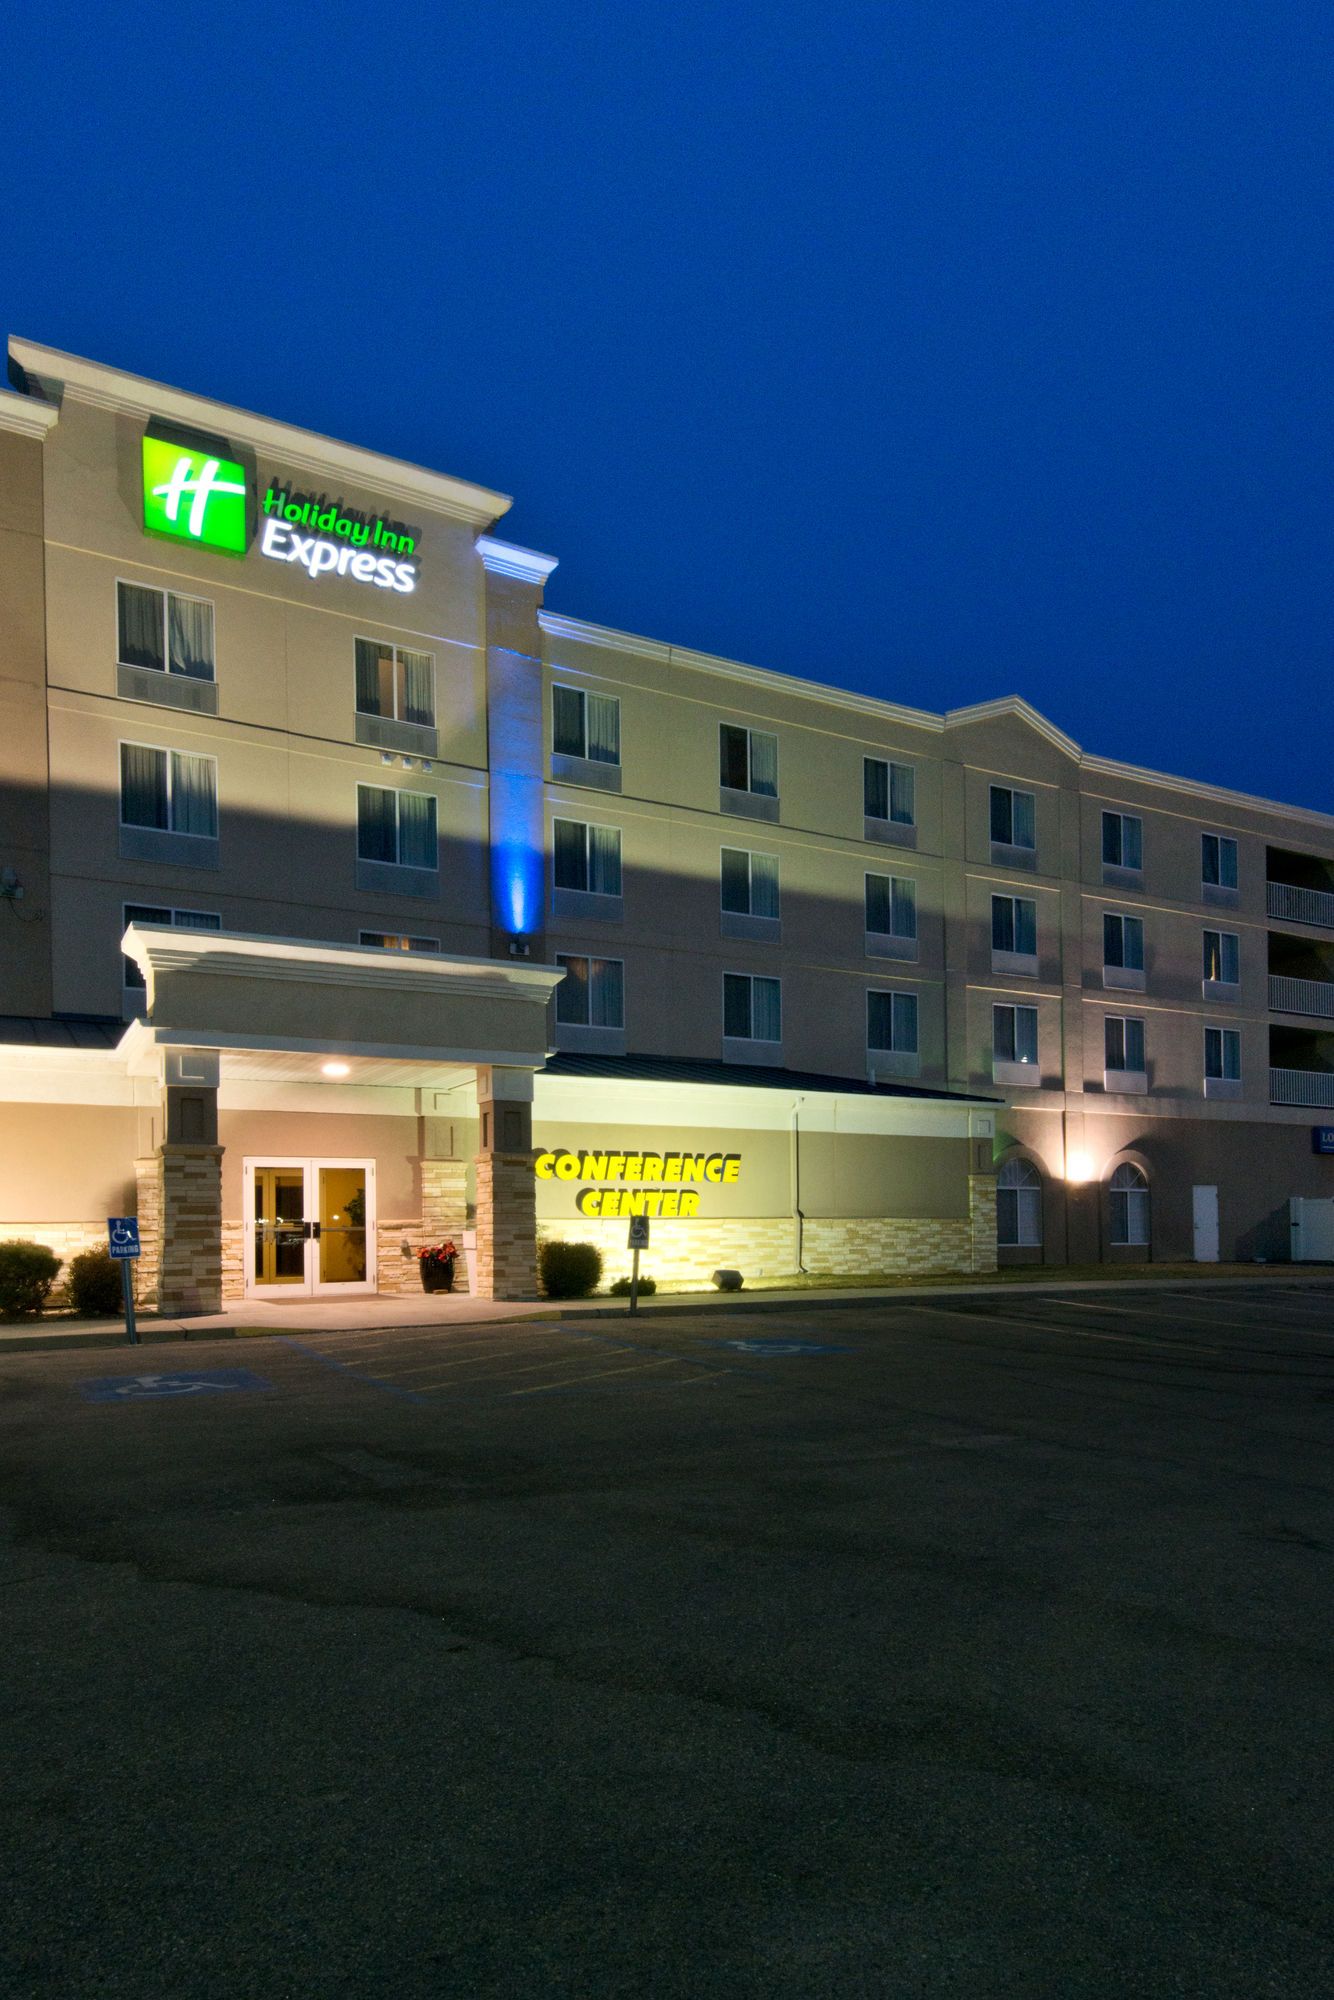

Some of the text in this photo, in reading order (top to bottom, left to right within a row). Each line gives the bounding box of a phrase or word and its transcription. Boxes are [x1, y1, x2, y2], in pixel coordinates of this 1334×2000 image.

[262, 488, 414, 555] Holiday Inn
[261, 518, 417, 593] Express
[535, 1153, 741, 1183] CONFERENCE
[581, 1191, 700, 1217] CENTER
[112, 1245, 139, 1254] PARKING
